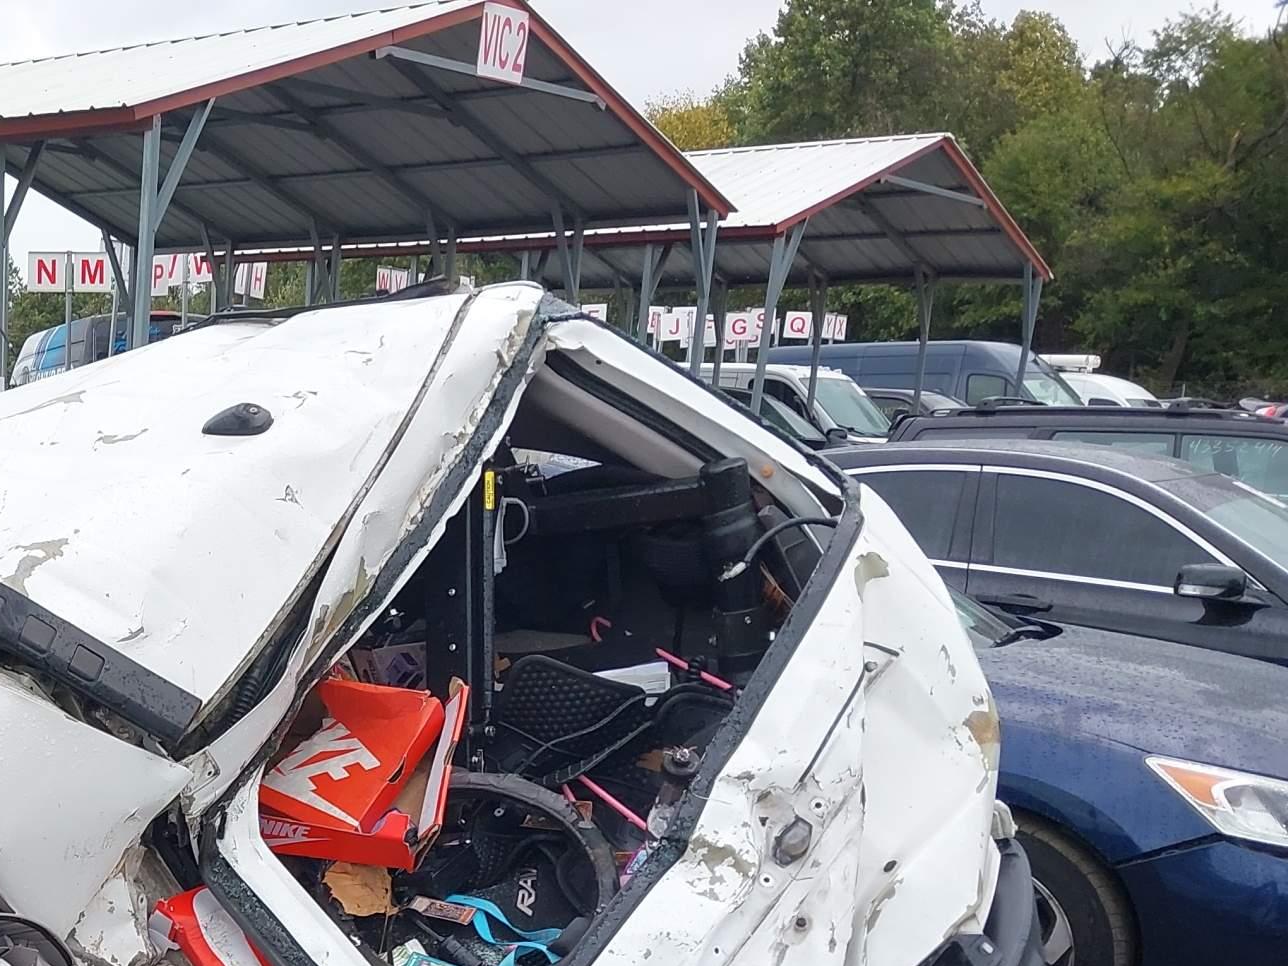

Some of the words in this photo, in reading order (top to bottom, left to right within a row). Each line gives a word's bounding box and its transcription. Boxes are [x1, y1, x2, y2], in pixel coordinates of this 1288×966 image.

[483, 12, 512, 70] VIC
[512, 22, 526, 72] 2
[37, 259, 56, 284] N
[81, 259, 104, 284] M
[153, 264, 164, 288] P
[253, 267, 264, 291] H
[378, 271, 389, 289] W
[668, 318, 680, 335] J
[731, 318, 747, 335] G
[790, 316, 806, 334] Q
[825, 317, 834, 334] Y
[836, 318, 845, 336] X
[260, 818, 312, 839] NIKE
